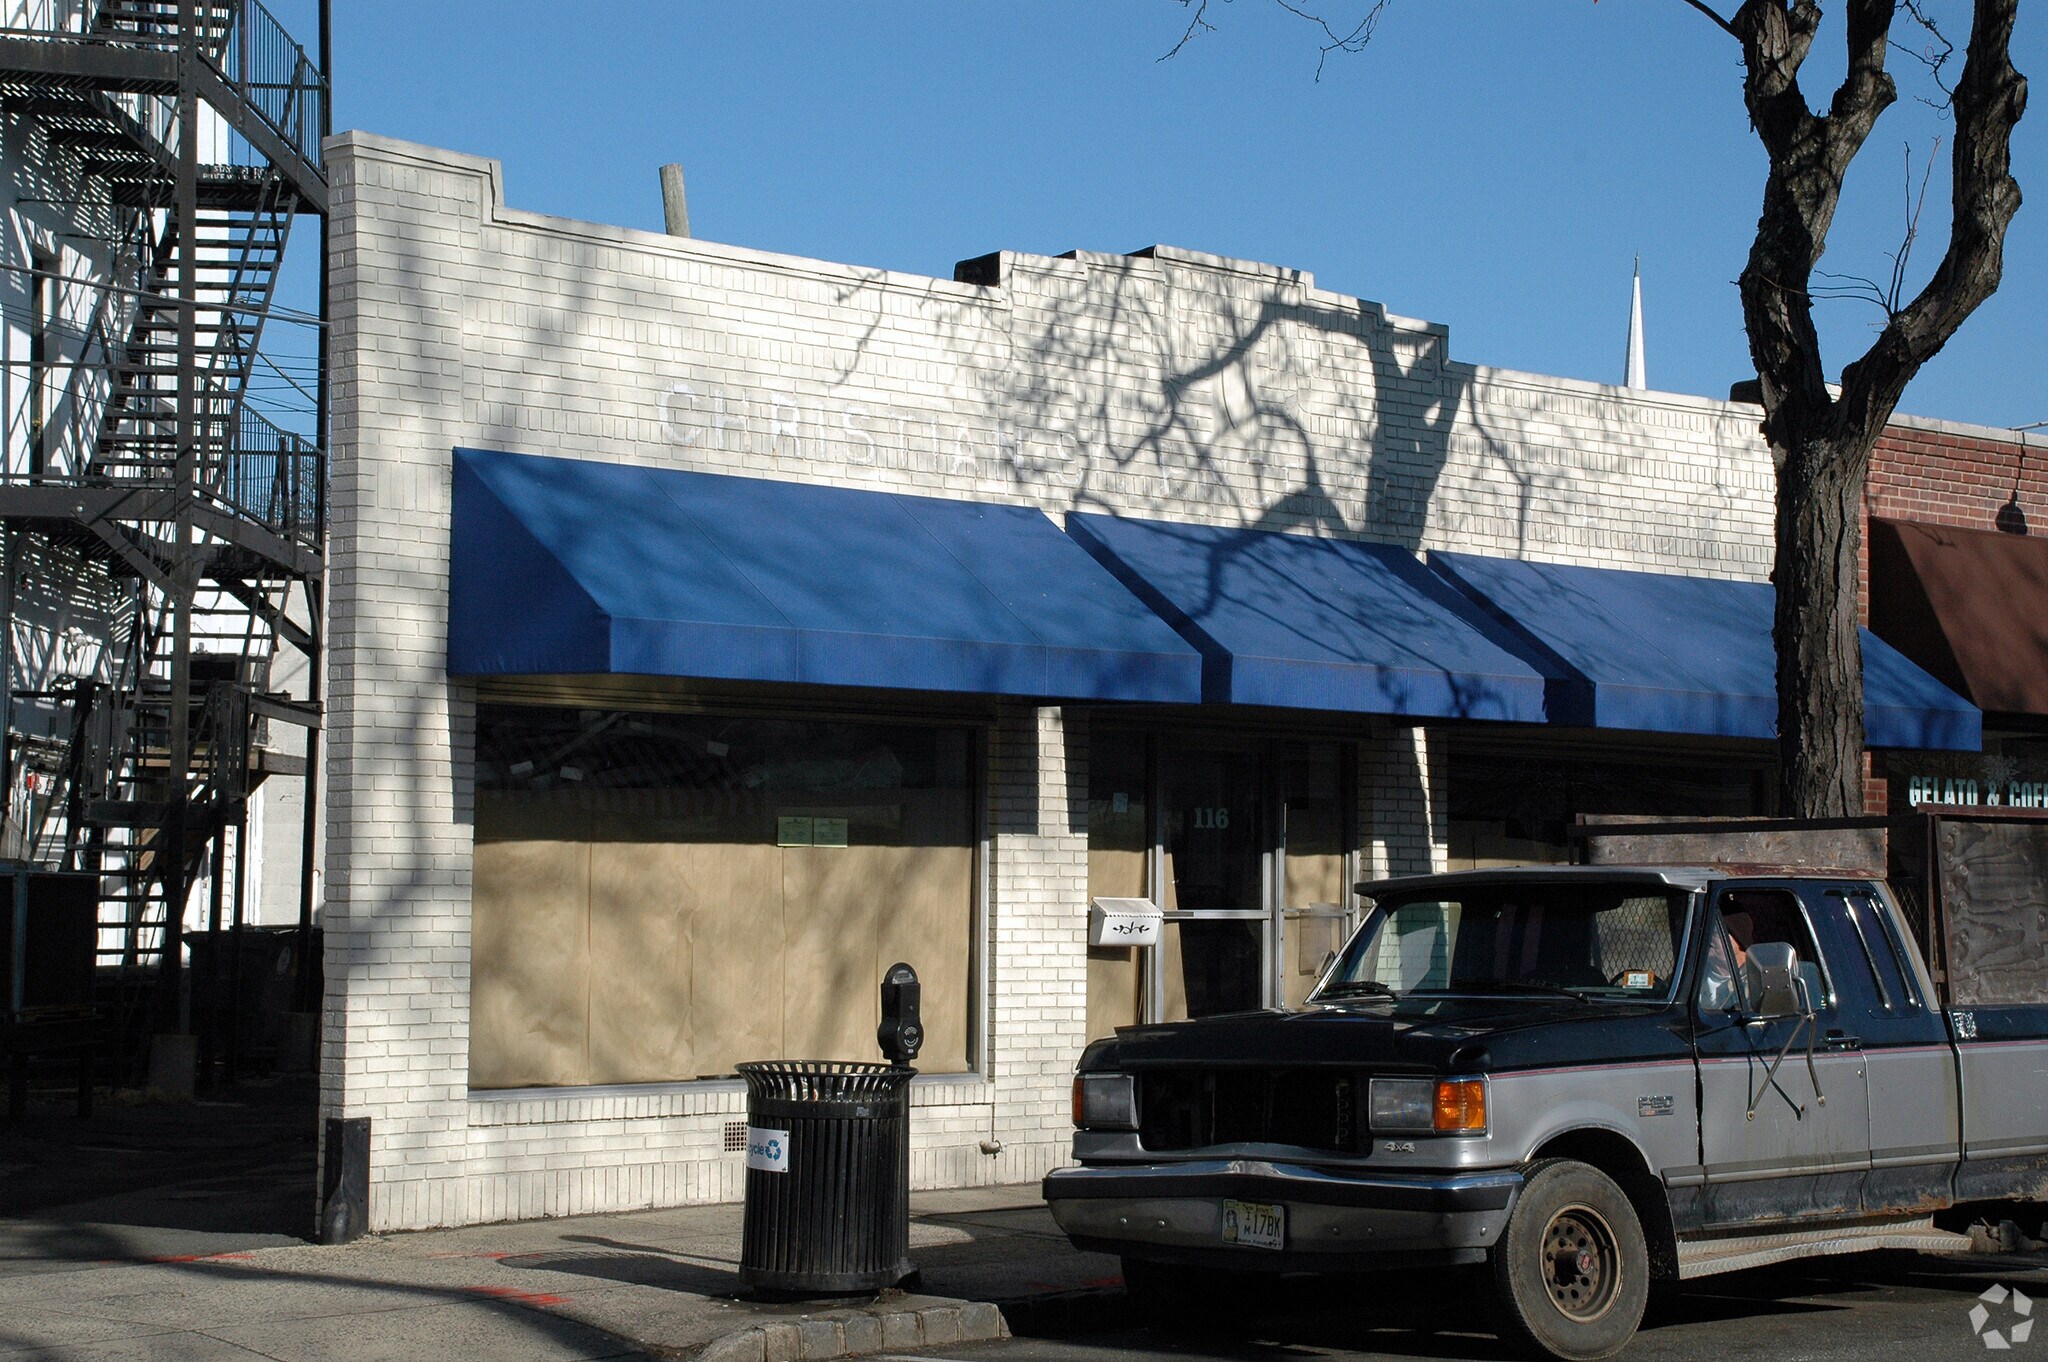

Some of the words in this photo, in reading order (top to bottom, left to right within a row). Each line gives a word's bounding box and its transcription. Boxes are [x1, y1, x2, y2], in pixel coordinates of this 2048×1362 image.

[1909, 775, 1978, 807] GELATO
[1987, 779, 2000, 806] &
[1193, 807, 1230, 829] 116
